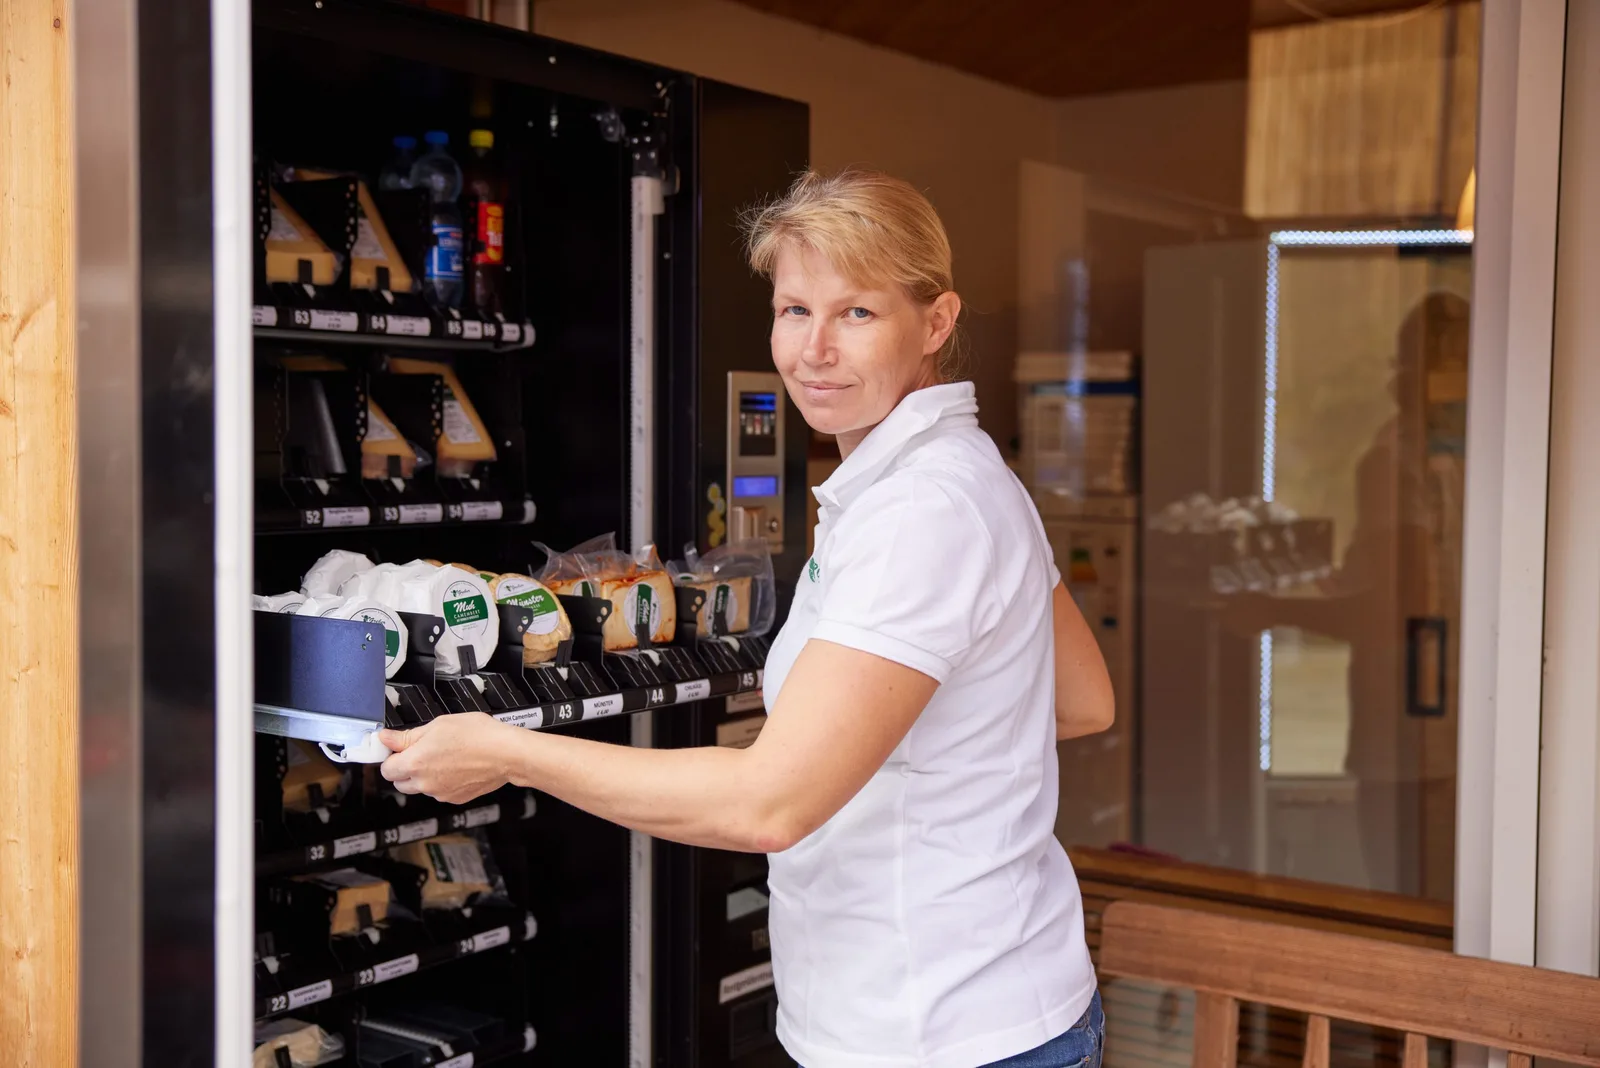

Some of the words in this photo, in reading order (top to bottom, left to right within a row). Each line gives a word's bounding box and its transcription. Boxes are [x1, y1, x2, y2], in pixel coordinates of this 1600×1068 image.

[305, 510, 321, 525] 52
[384, 506, 399, 521] 53
[742, 672, 754, 687] 45
[651, 688, 664, 703] 44
[593, 699, 614, 708] MÜNSTER
[499, 715, 512, 723] MUH
[512, 711, 538, 721] Camembert
[558, 704, 573, 720] 43
[384, 828, 398, 843] 33
[310, 845, 325, 860] 32
[460, 939, 474, 953] 24
[359, 968, 374, 984] 23
[271, 995, 287, 1012] 22
